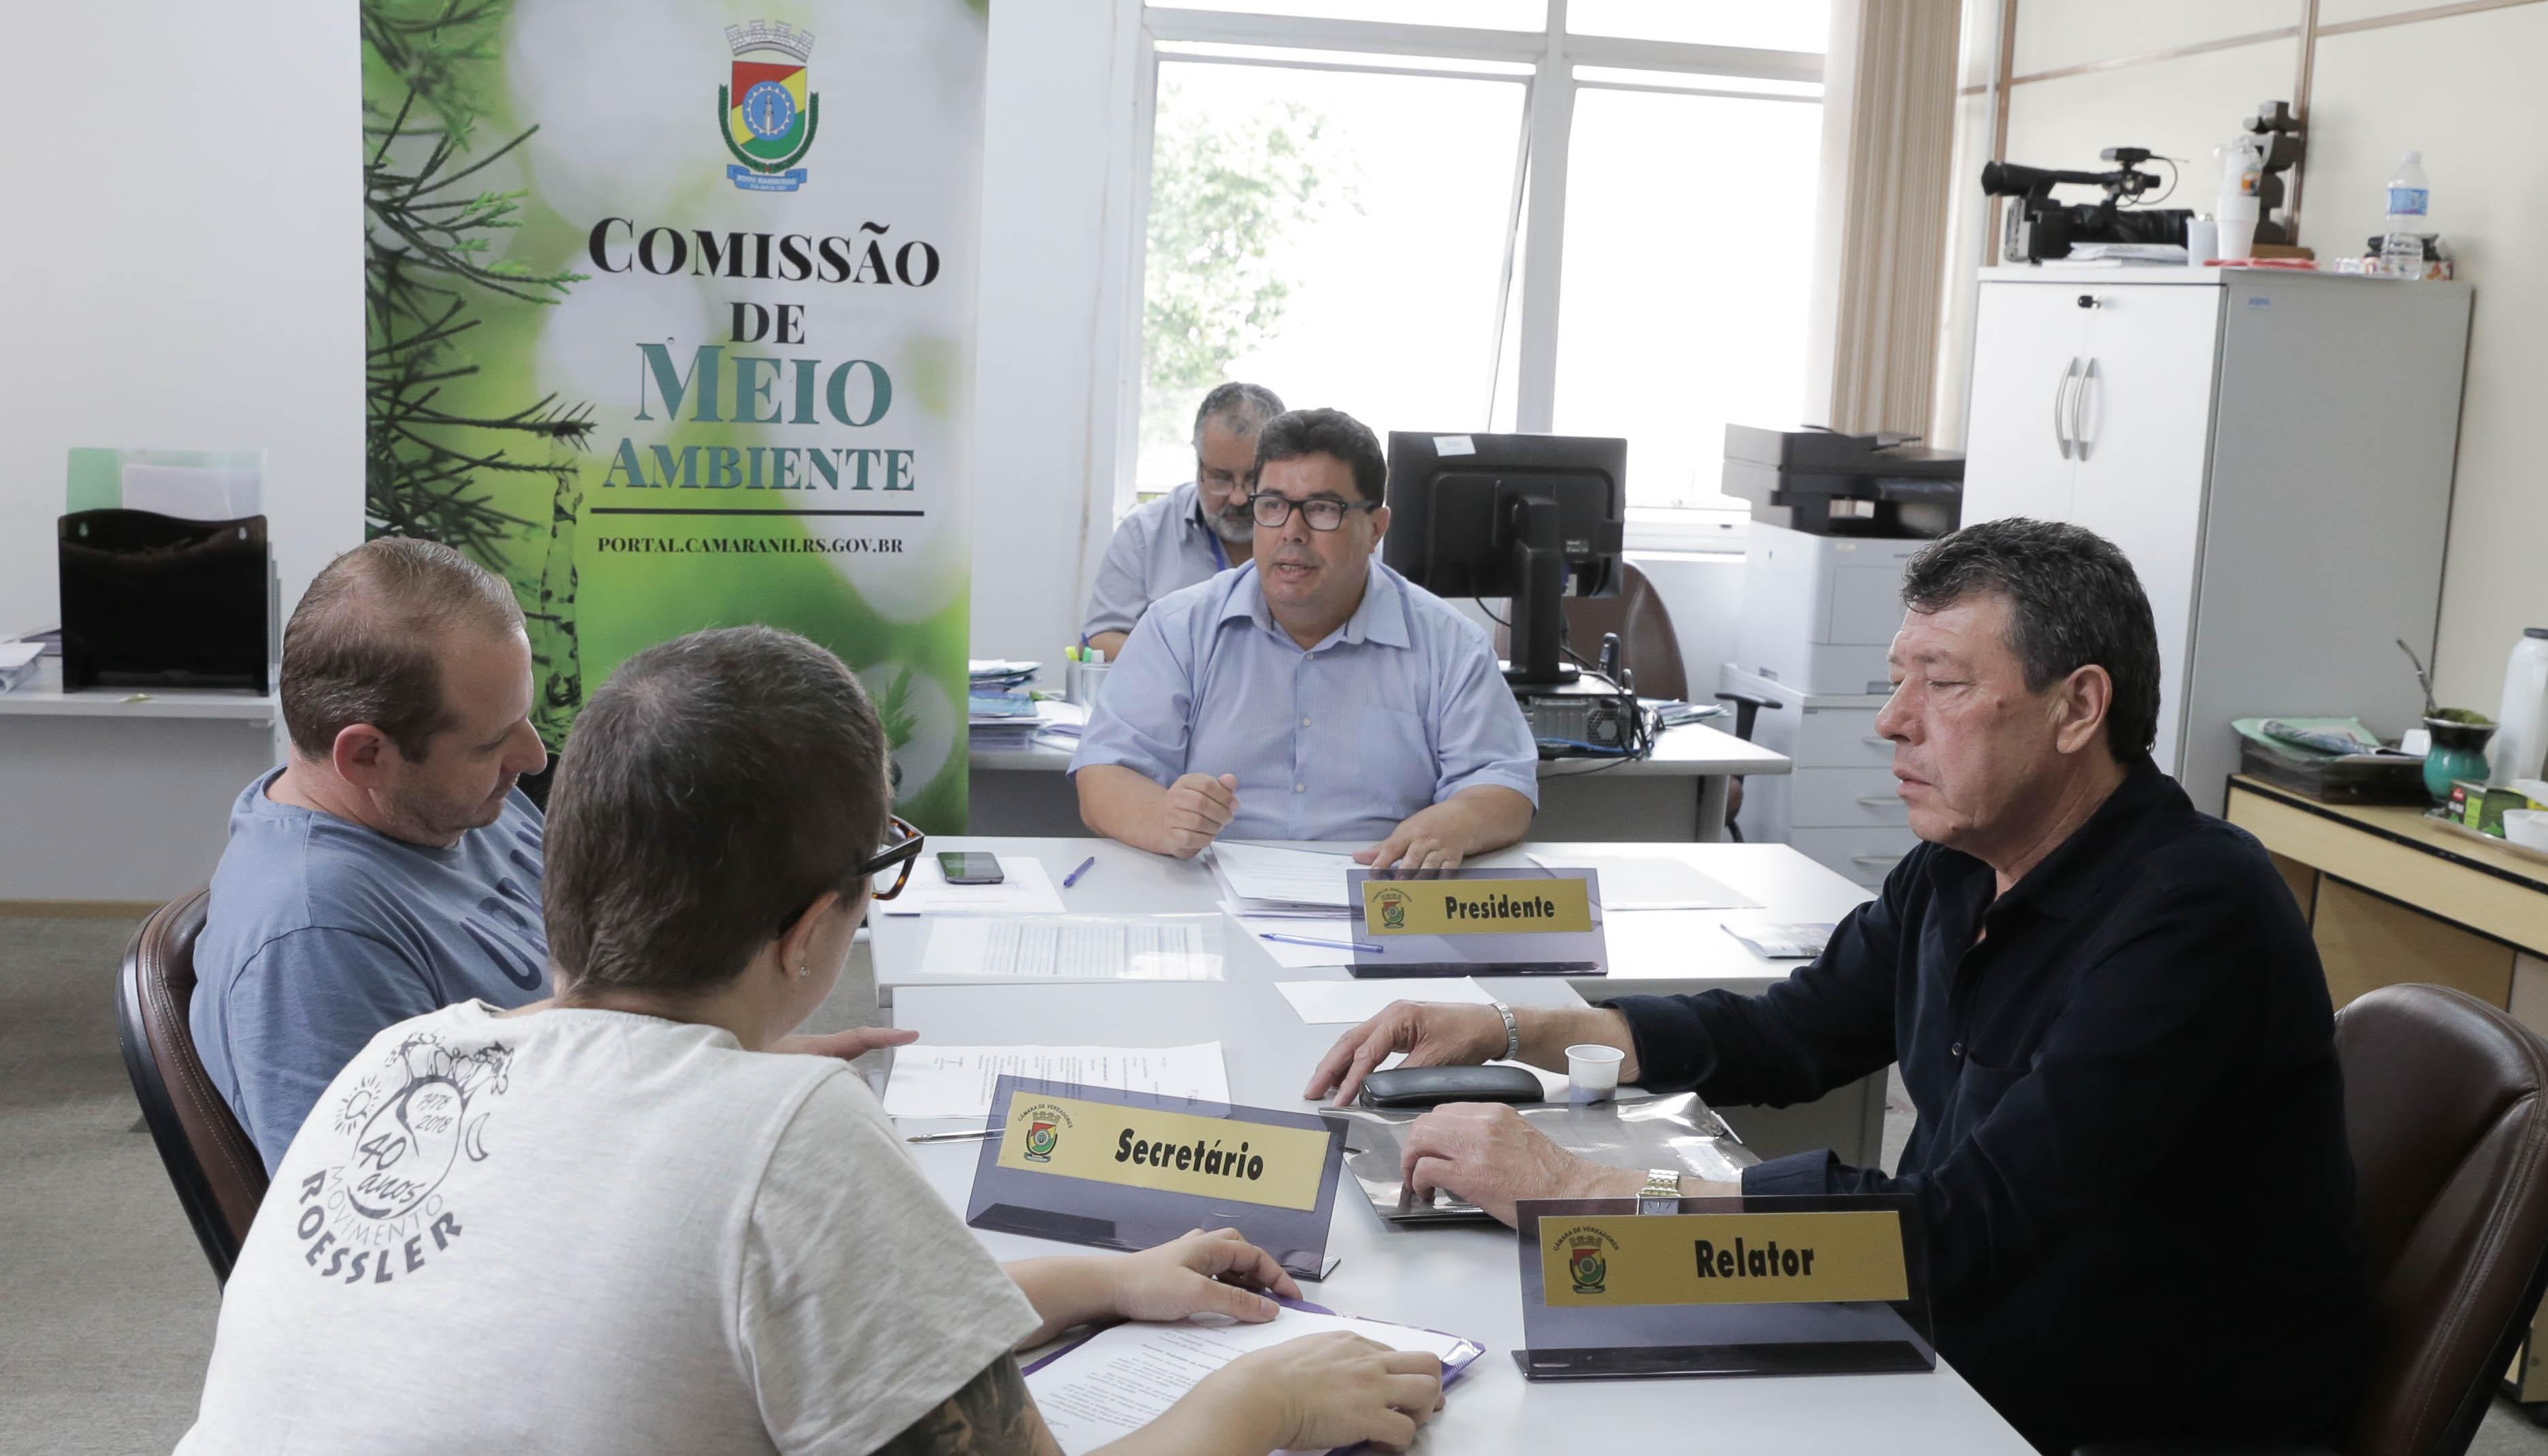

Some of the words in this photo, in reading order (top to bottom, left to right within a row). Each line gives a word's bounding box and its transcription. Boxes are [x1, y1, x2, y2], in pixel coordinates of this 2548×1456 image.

[728, 302, 805, 344] DE
[634, 342, 892, 427] MEIO
[602, 437, 915, 491] AMBIENTE
[598, 538, 903, 554] PORTAL.CAMARANH.RS.GOV.BR
[1445, 894, 1555, 920] Presidente
[415, 1115, 453, 1133] 2018
[1047, 1104, 1074, 1129] VEREADORES
[359, 1131, 407, 1170] 40
[1114, 1128, 1264, 1181] Secretário
[326, 1166, 443, 1246] MOVIMENTO
[357, 1173, 427, 1203] anos
[297, 1169, 463, 1284] ROESSLER
[1694, 1237, 1815, 1279] Relator
